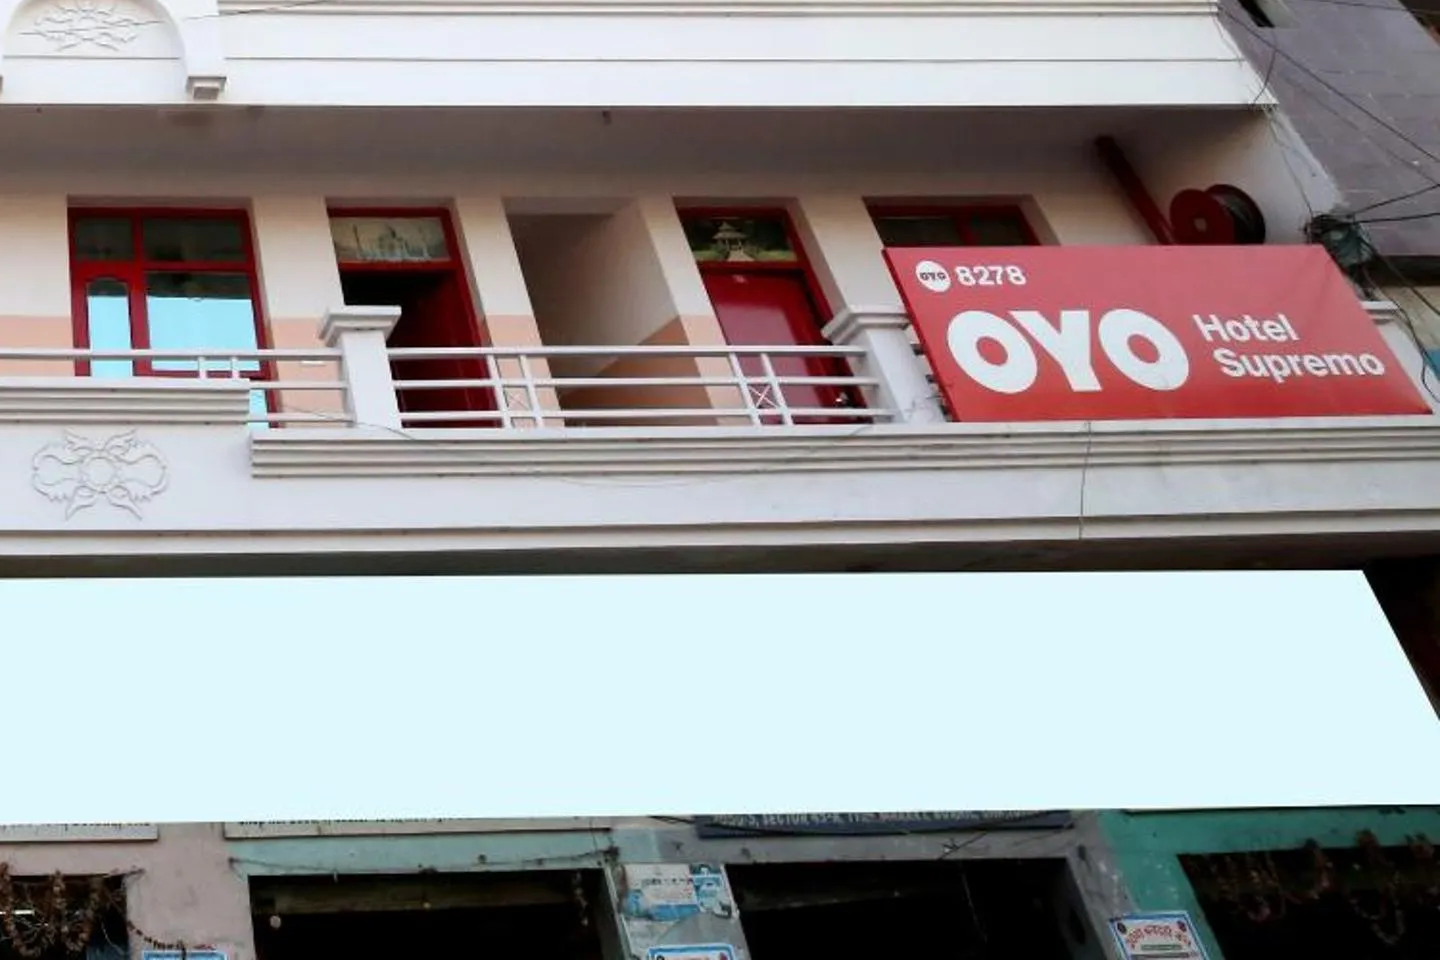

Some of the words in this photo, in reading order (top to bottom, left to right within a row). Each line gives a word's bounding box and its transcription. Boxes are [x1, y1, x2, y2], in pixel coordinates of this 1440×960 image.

[954, 266, 1027, 286] 8278
[1192, 313, 1300, 342] Hotel
[947, 308, 1190, 394] OYO
[1213, 347, 1385, 383] Supremo
